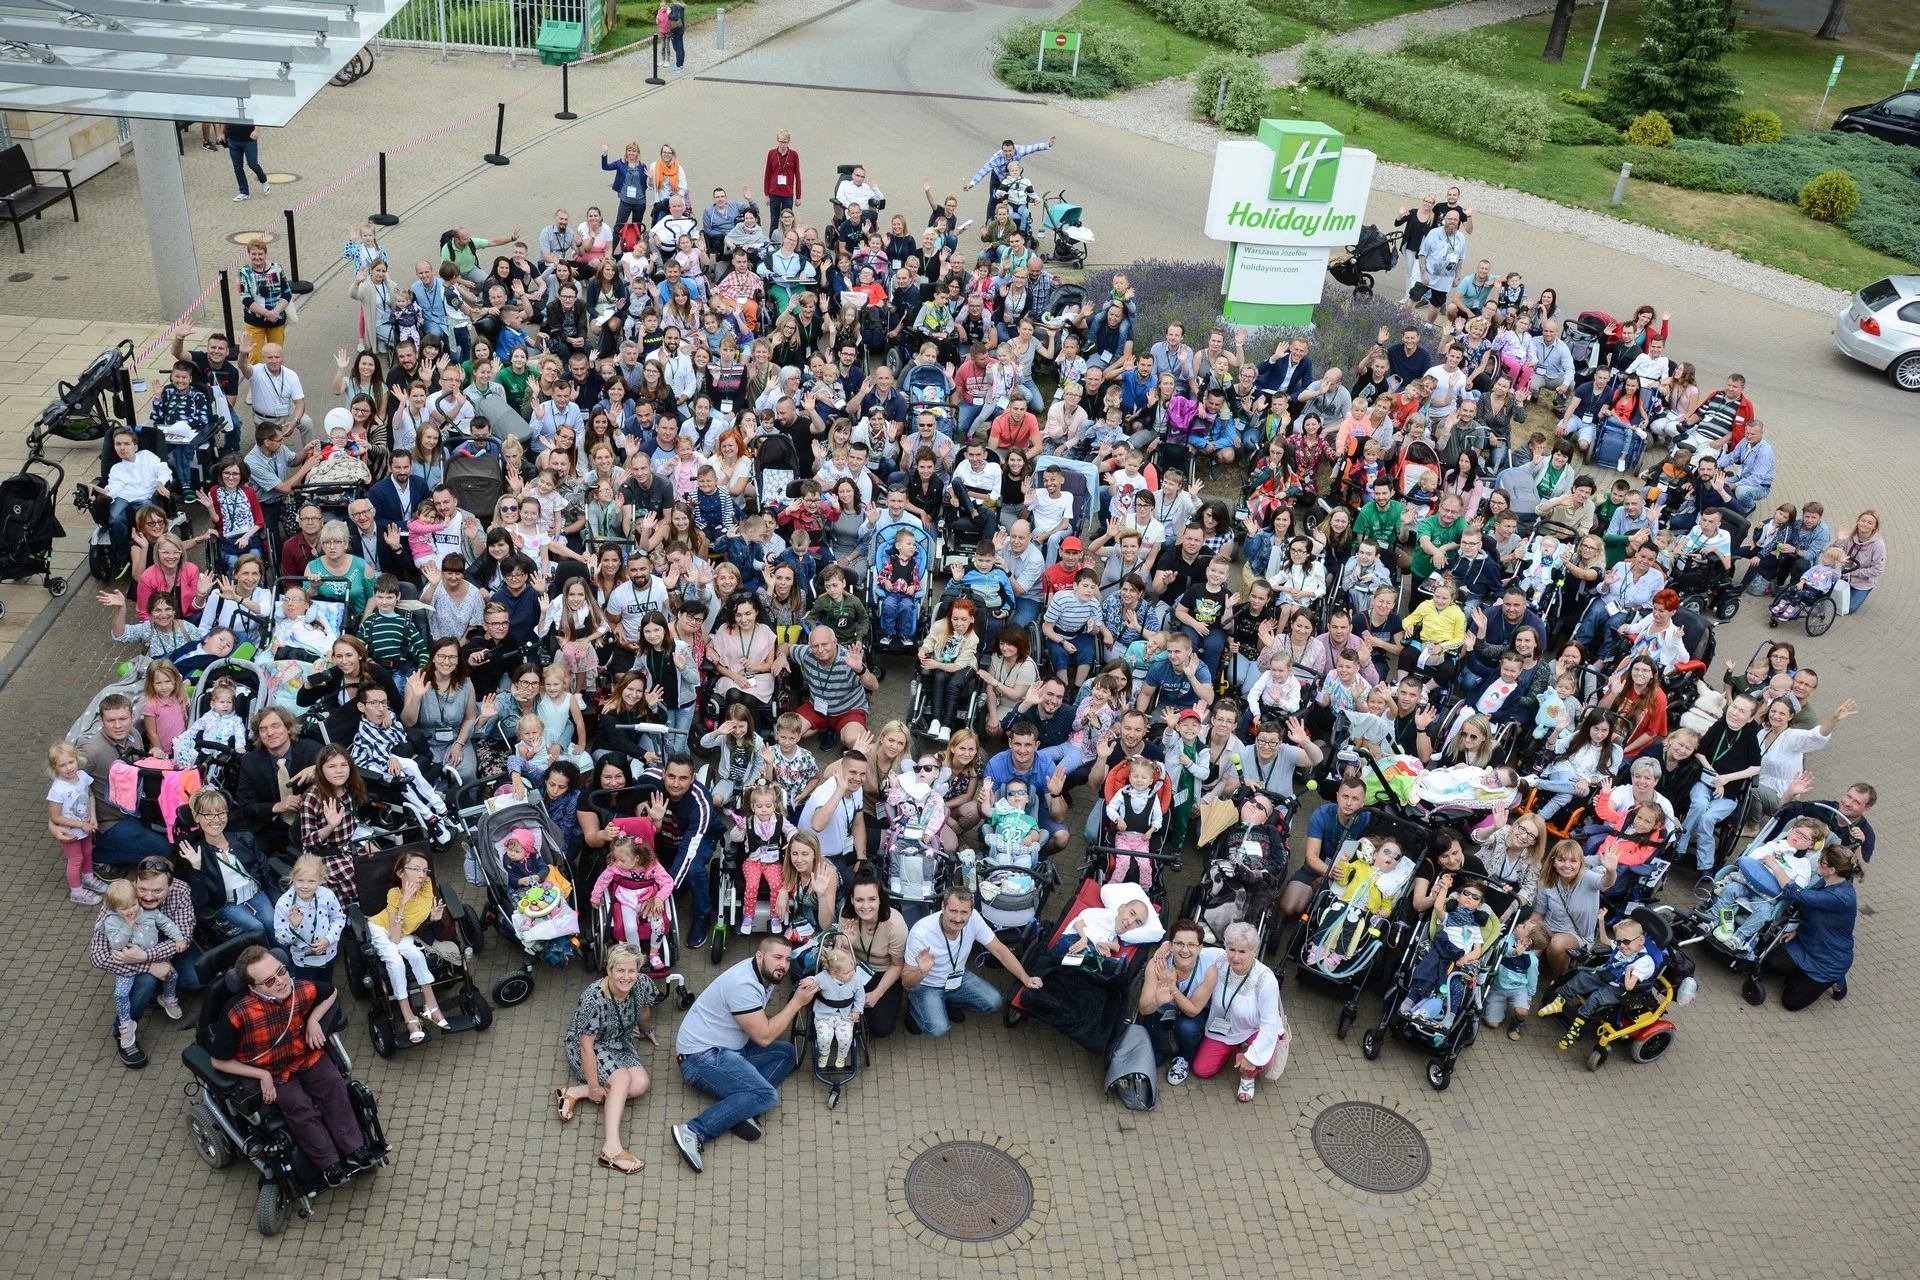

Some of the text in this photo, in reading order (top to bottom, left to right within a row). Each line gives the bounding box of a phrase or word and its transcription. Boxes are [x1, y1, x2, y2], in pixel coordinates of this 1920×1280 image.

[1227, 201, 1356, 237] Holiday Inn
[1244, 246, 1308, 257] Warszawa Józefów
[1240, 262, 1299, 273] holidayinn.com
[446, 535, 459, 544] SMA
